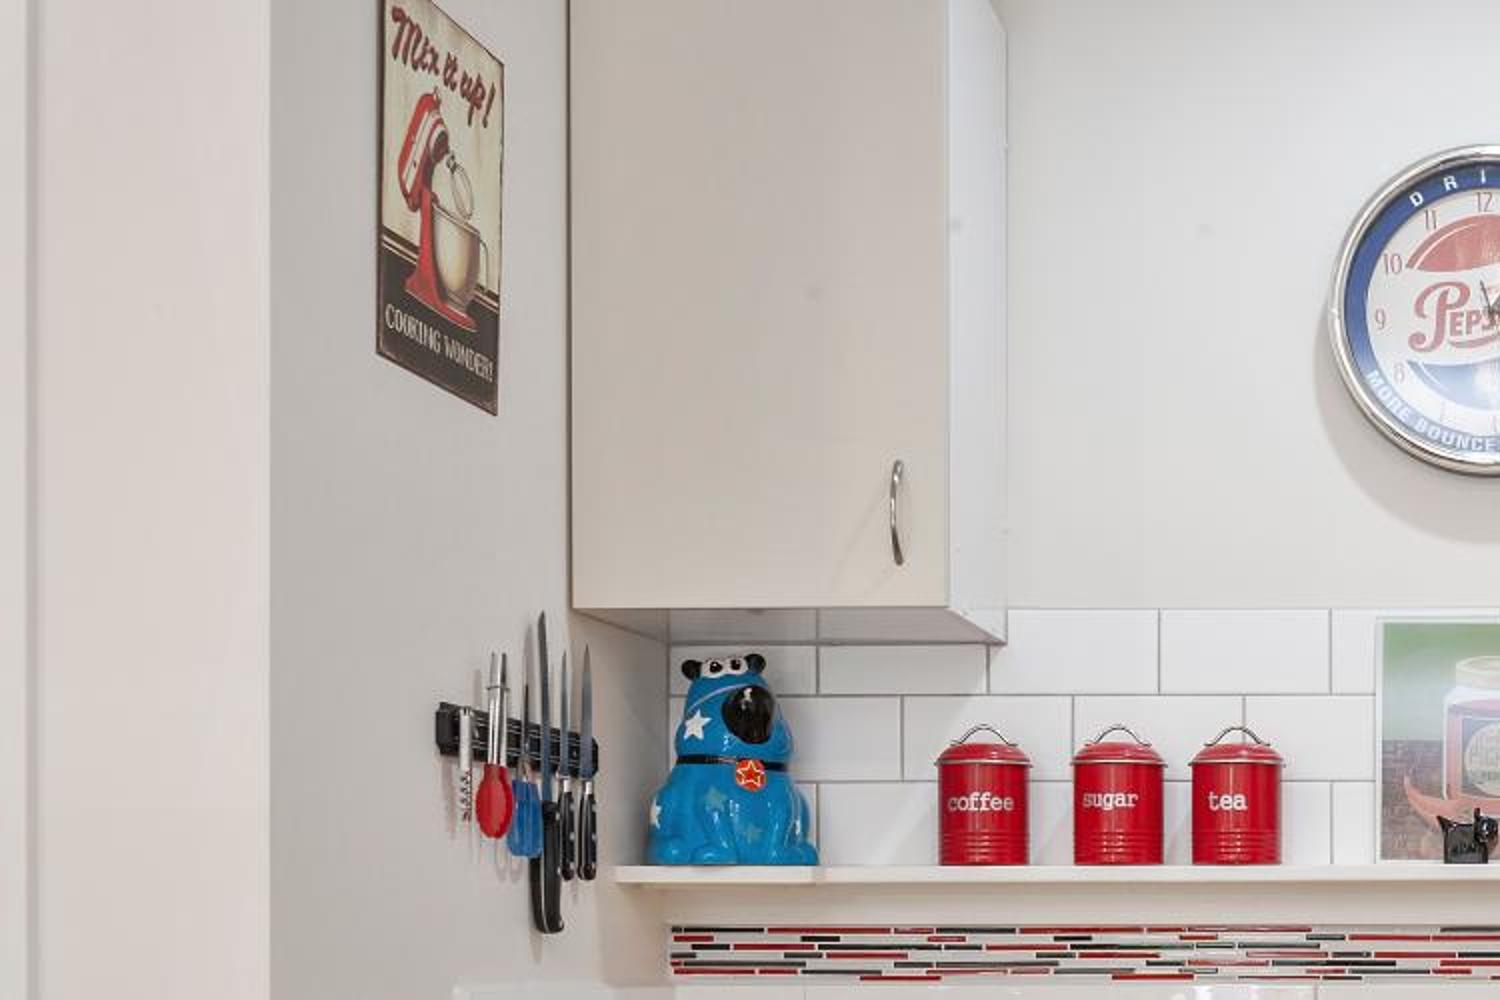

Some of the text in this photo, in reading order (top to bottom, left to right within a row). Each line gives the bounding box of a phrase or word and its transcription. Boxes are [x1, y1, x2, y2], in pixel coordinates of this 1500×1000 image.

[392, 5, 496, 128] Mix it up!
[1475, 192, 1494, 213] 12
[1424, 208, 1438, 230] 11
[1383, 253, 1403, 275] 10
[1375, 307, 1386, 330] 9
[1366, 368, 1411, 424] MORE
[1413, 417, 1497, 452] BOUNCE
[948, 791, 1014, 812] coffee
[1082, 792, 1139, 811] sugar
[1208, 791, 1248, 811] tea
